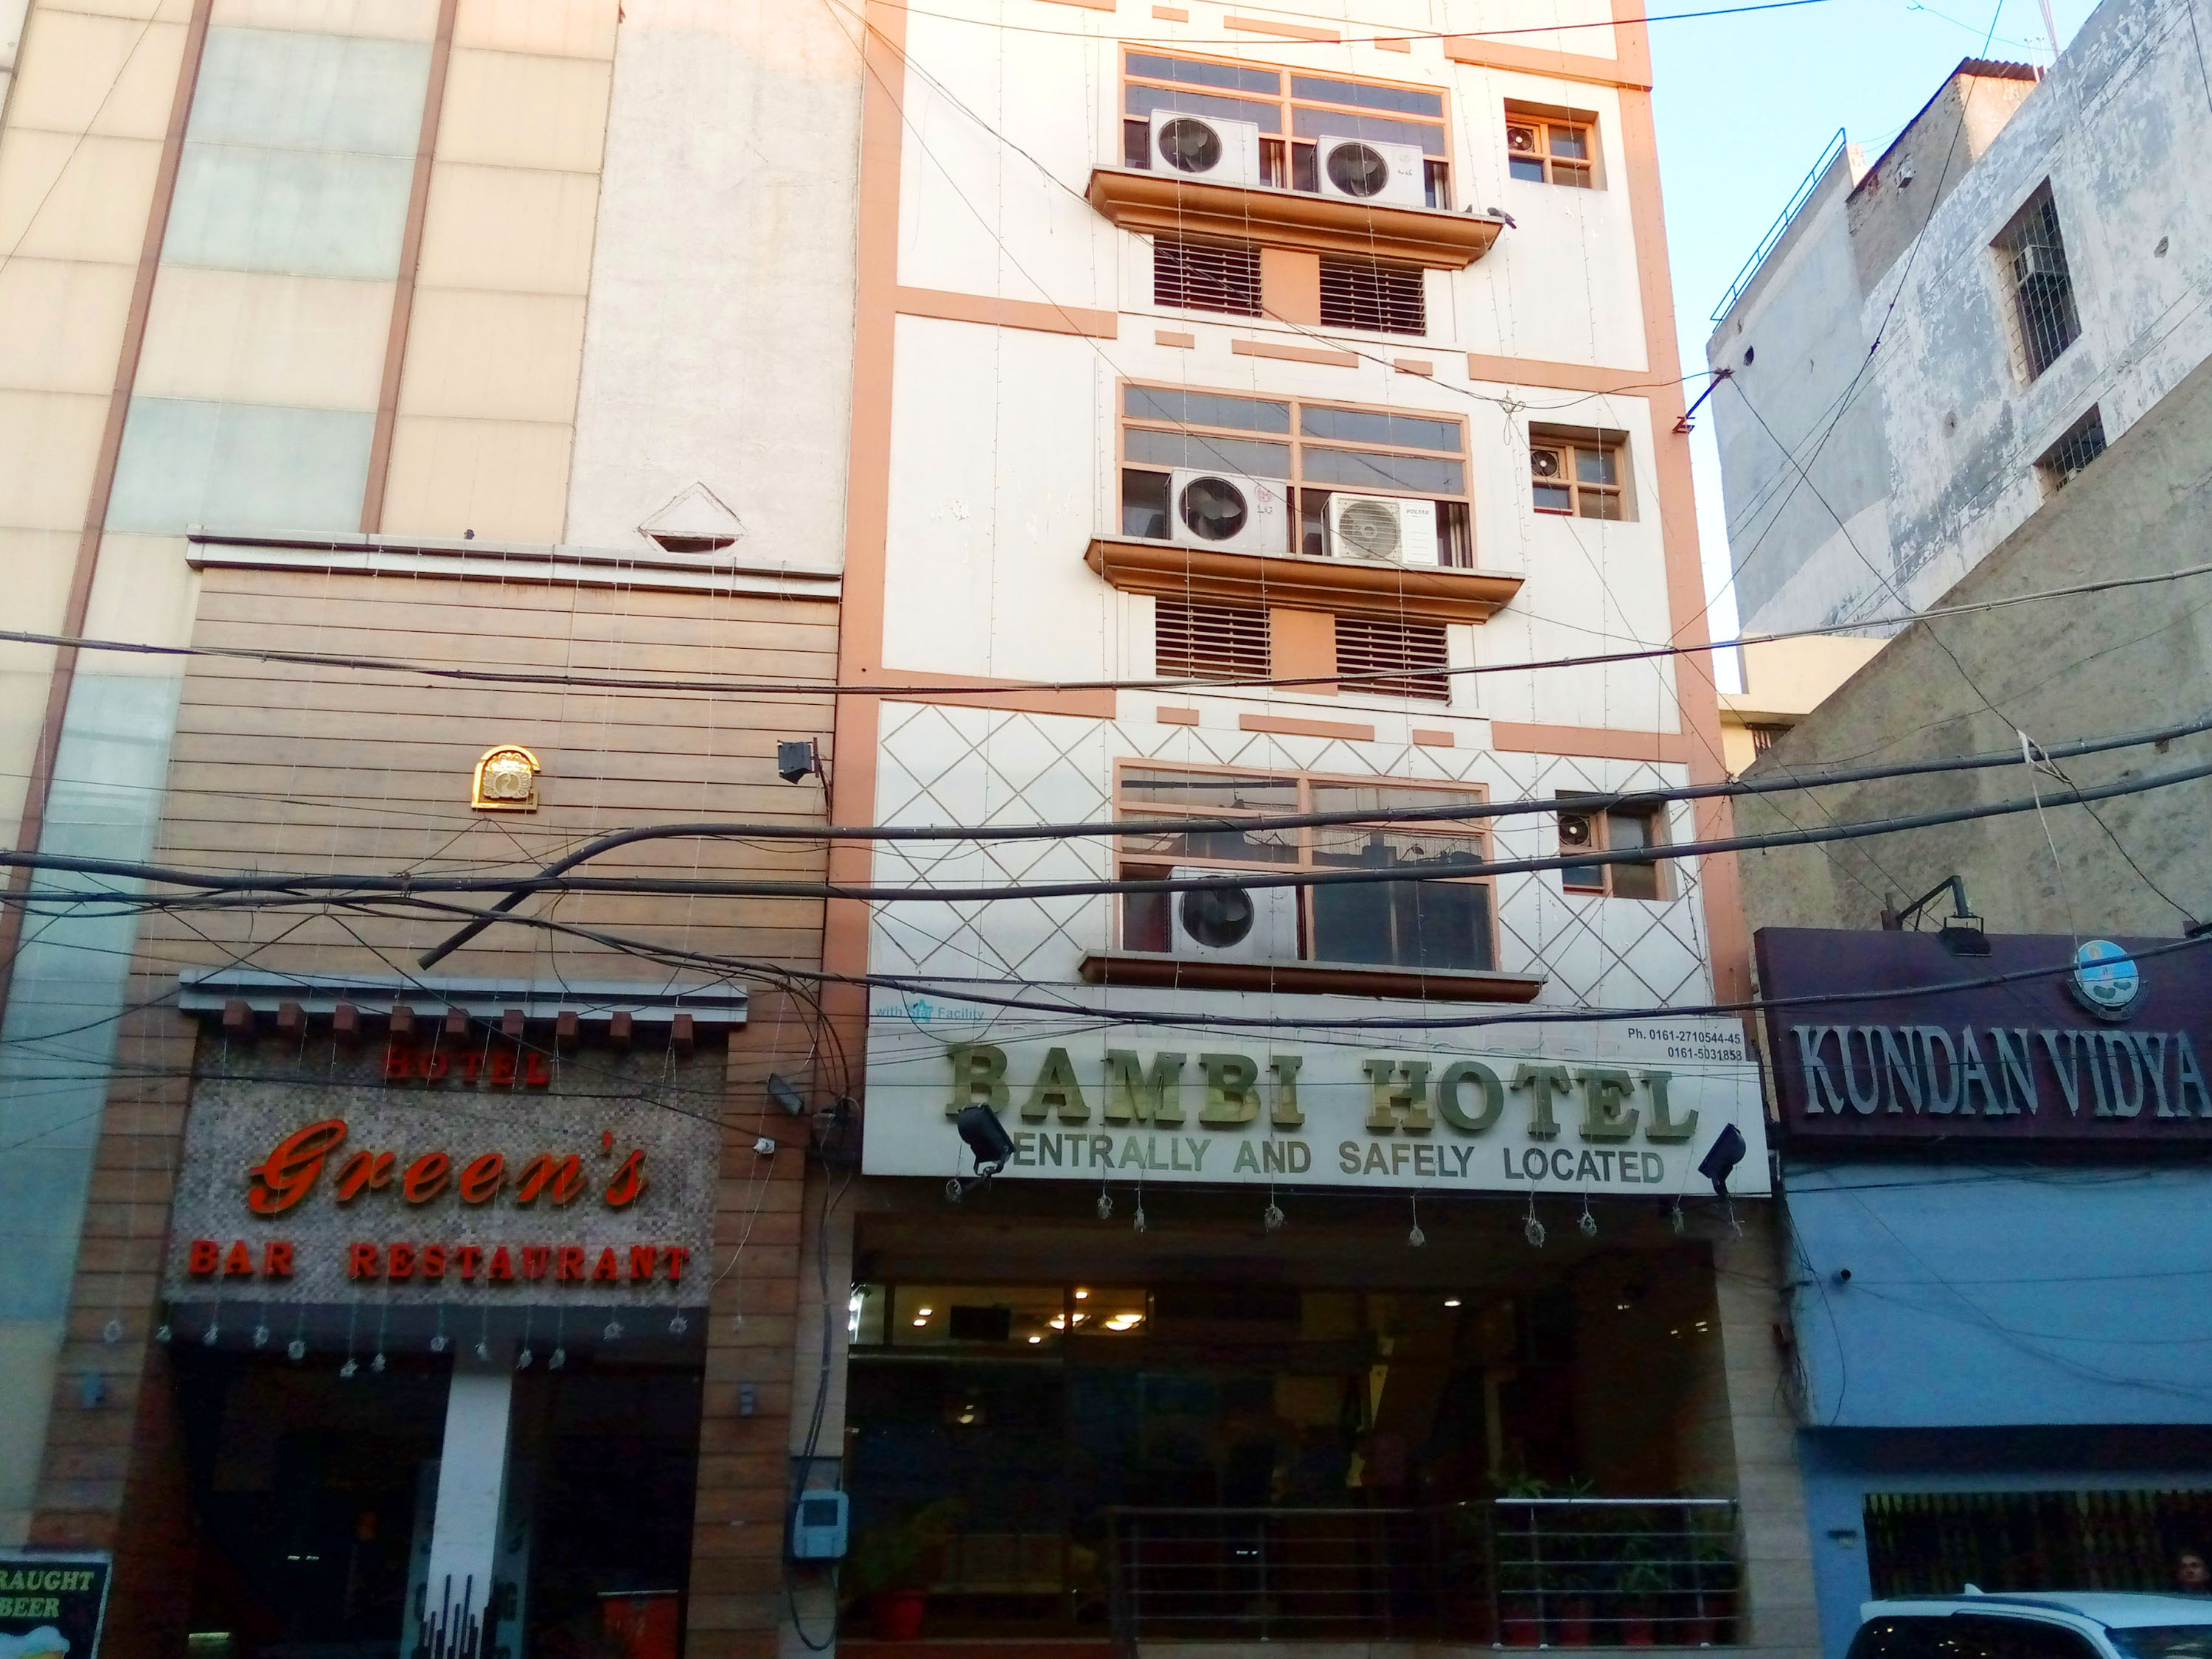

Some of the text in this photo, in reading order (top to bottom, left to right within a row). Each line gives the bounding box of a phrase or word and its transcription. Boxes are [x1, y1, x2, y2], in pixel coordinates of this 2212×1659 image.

[875, 1006, 902, 1017] with
[938, 1007, 984, 1021] Facility
[1628, 1028, 1741, 1043] Ph. 0161-2710544-45
[1668, 1046, 1742, 1061] 0161-5031858
[383, 1047, 550, 1088] HOTEL
[1790, 1023, 2212, 1118] KUNDAN VIDYA
[945, 1043, 1698, 1140] BAMBI HOTEL
[248, 1119, 649, 1215] Green's
[1012, 1132, 1664, 1183] ENTRALLY AND SAFELY LOCATED
[188, 1239, 690, 1281] BAR RESTAURANT
[0, 1597, 60, 1618] BEER
